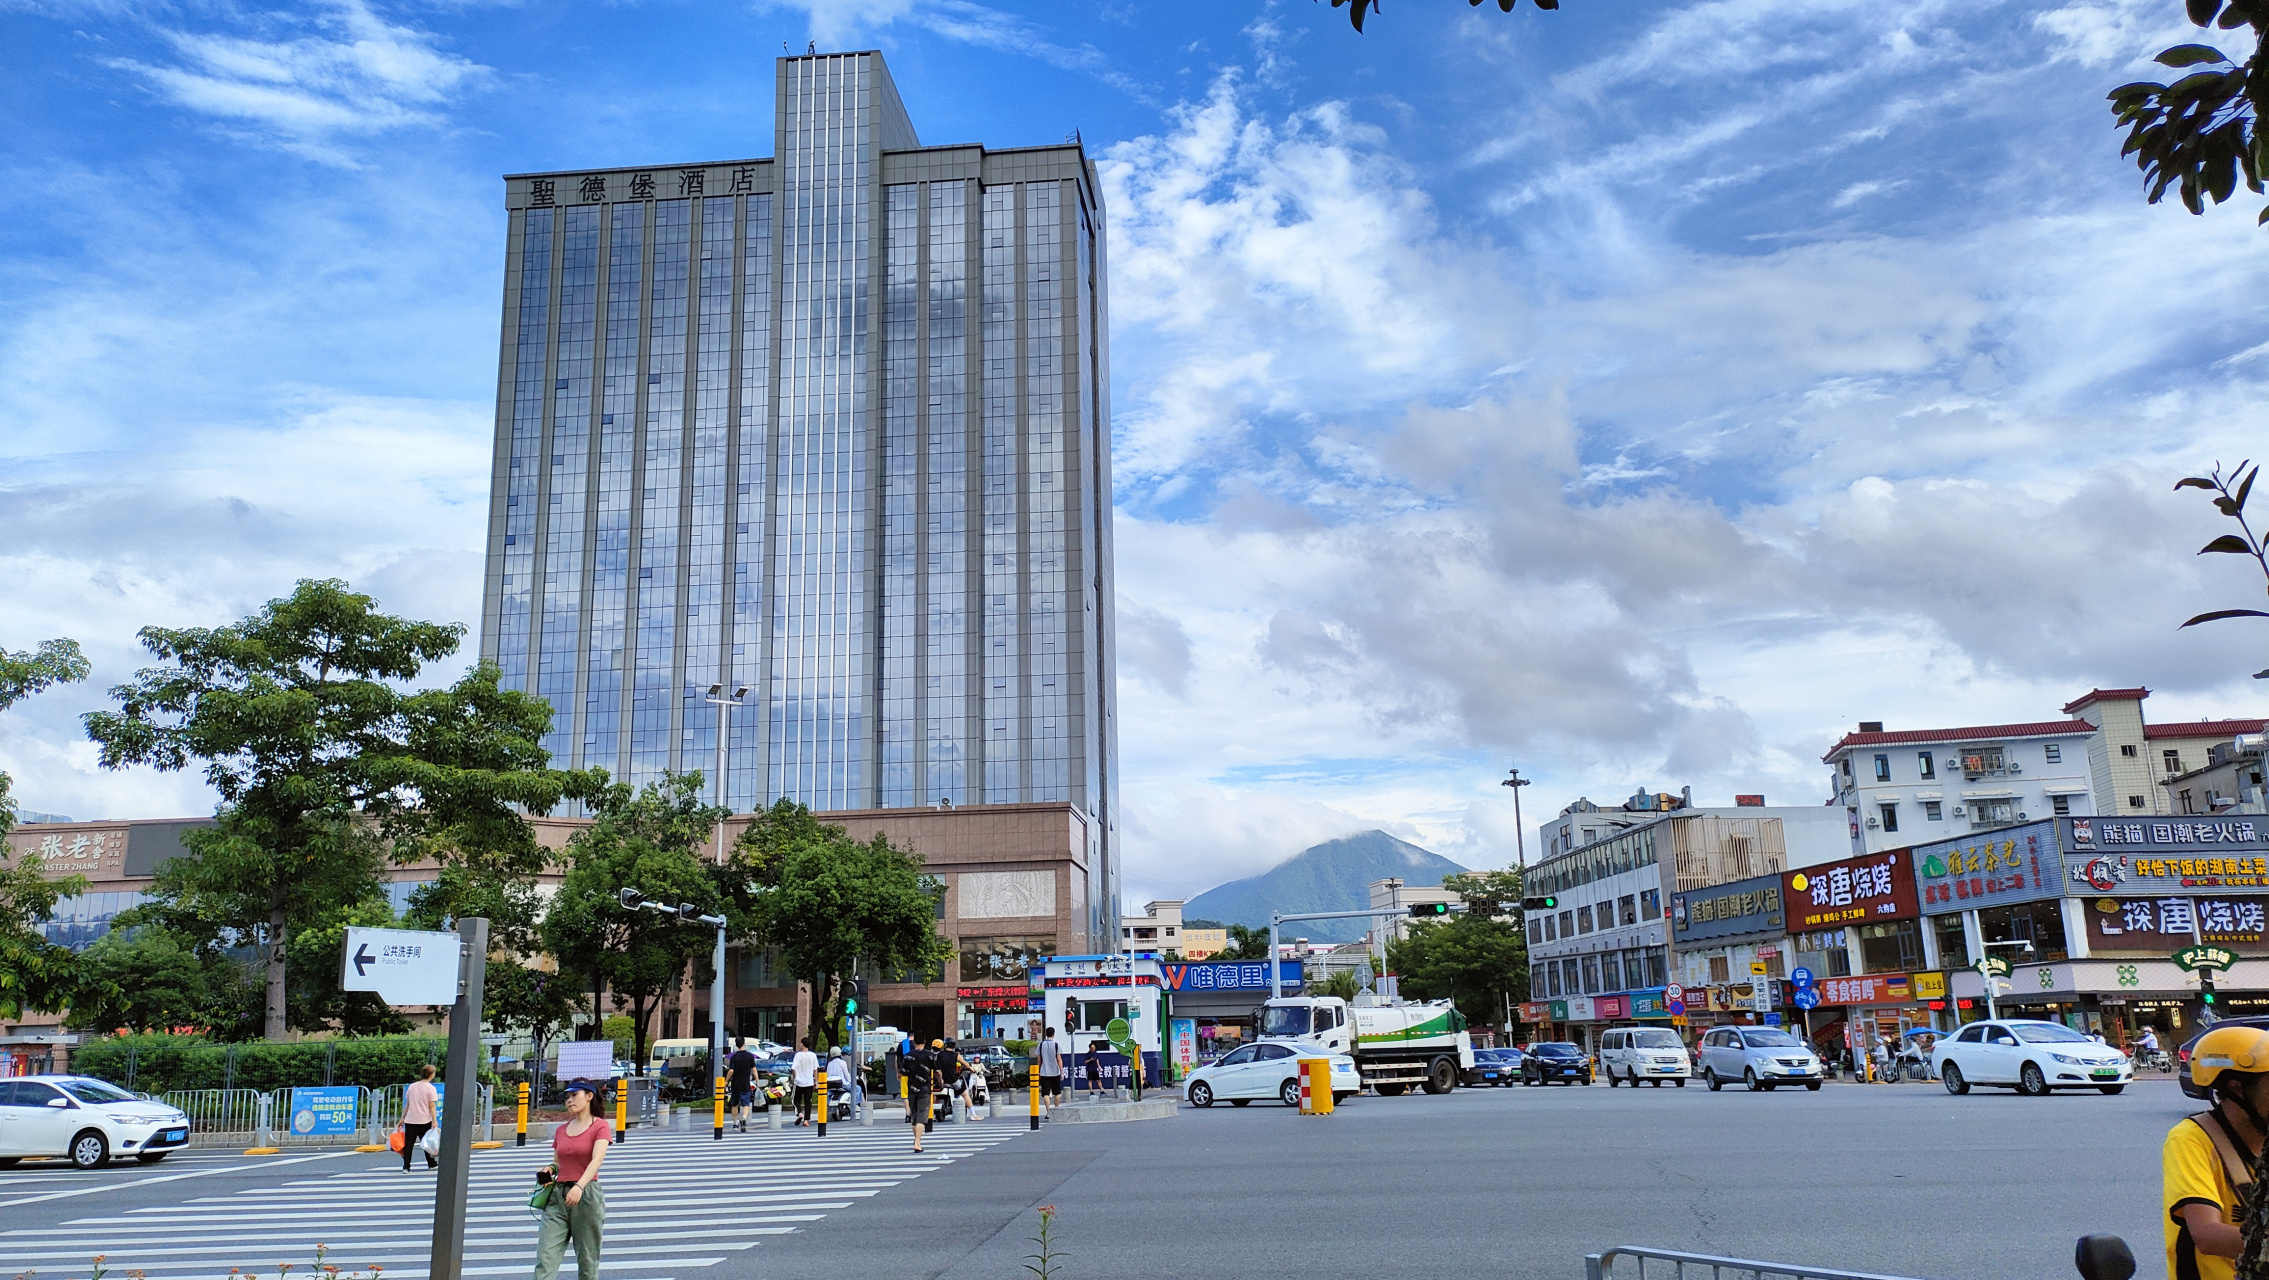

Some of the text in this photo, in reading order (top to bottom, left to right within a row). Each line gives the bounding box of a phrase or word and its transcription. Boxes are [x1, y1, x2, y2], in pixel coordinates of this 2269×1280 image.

[530, 166, 756, 206] 聖德堡酒店
[72, 862, 98, 870] ZHANG
[1948, 838, 2021, 877] 雅云茶艺
[1810, 863, 1892, 906] 探唐烧烤
[2122, 898, 2265, 934] 探唐烧烤
[381, 957, 409, 966] Public Toilet
[382, 944, 422, 959] 公共洗手间
[1190, 965, 1264, 989] 唯德里
[1670, 986, 1680, 996] 30
